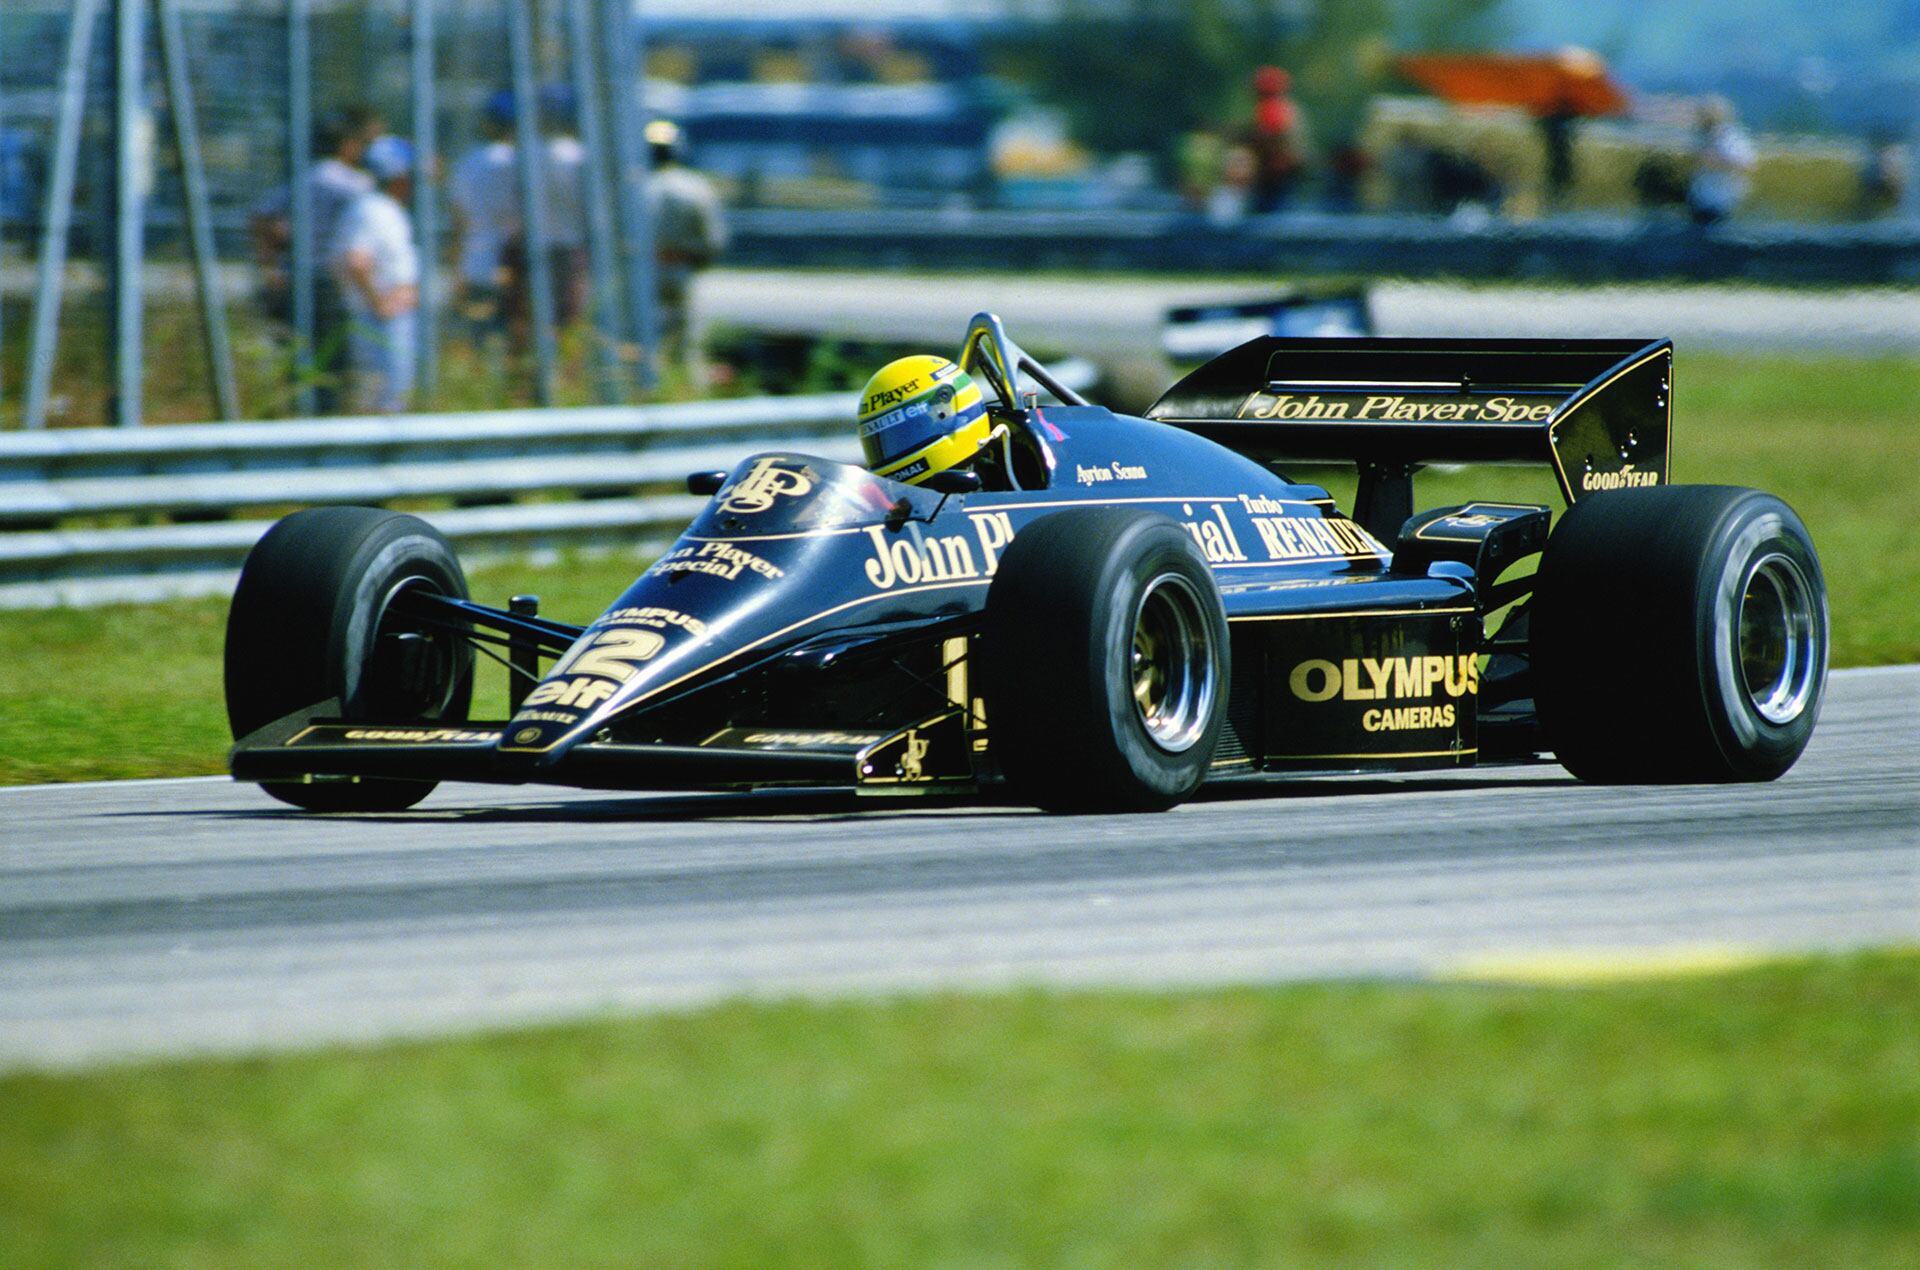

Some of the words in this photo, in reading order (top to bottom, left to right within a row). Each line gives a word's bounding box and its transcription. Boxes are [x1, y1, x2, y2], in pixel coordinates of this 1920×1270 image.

[869, 378, 920, 411] Player
[1254, 395, 1348, 418] John
[1350, 396, 1477, 419] Player
[1479, 397, 1556, 422] Spe
[862, 520, 980, 589] John
[1180, 502, 1248, 562] ial
[520, 677, 620, 709] elf
[1289, 652, 1478, 702] OLYMPUS
[1362, 704, 1456, 732] CAMERAS
